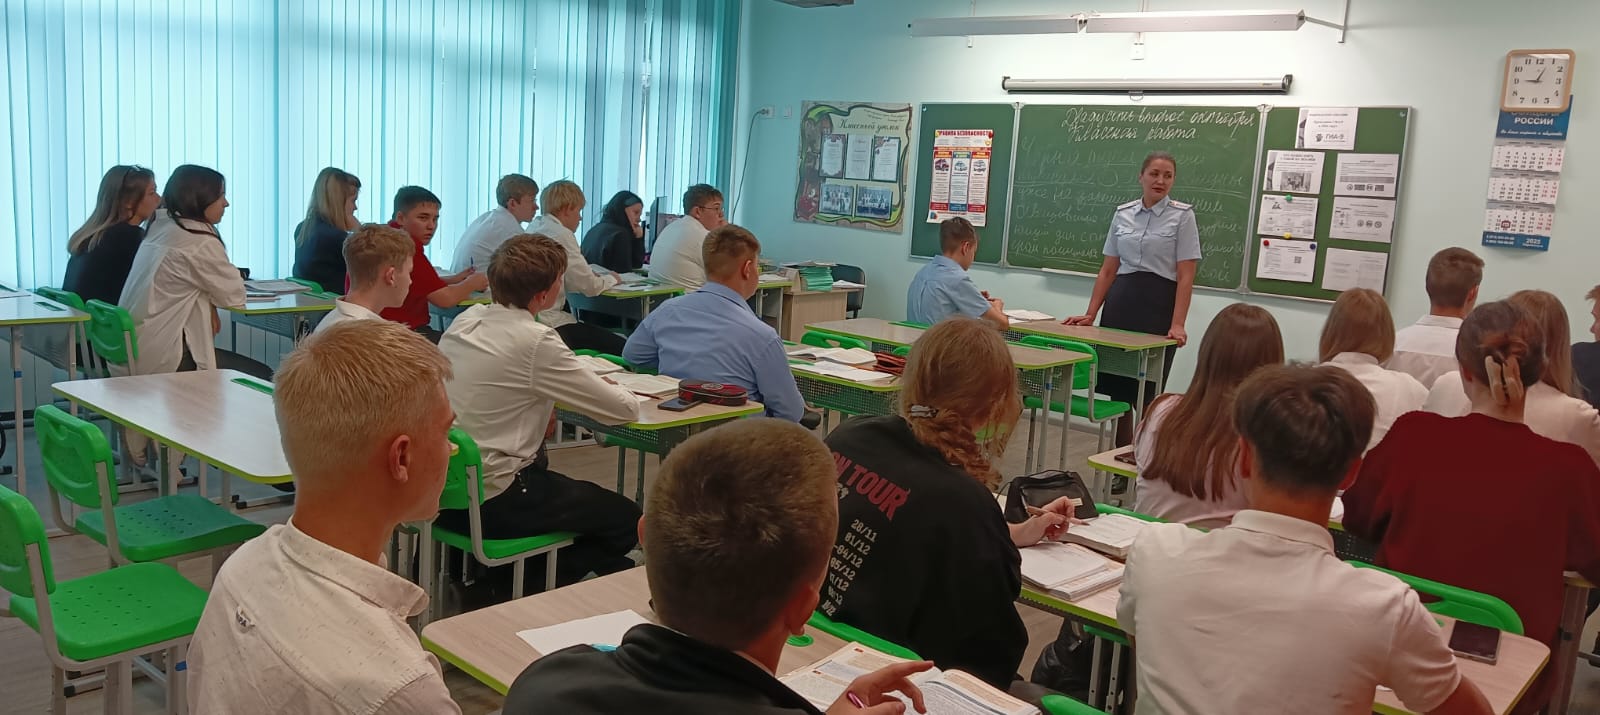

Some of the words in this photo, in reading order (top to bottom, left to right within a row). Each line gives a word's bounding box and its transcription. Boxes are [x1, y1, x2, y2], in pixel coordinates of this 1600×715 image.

[1514, 117, 1554, 126] РОССИИ
[1144, 124, 1196, 143] работа
[846, 464, 910, 521] TOUR
[851, 519, 877, 543] 28/11
